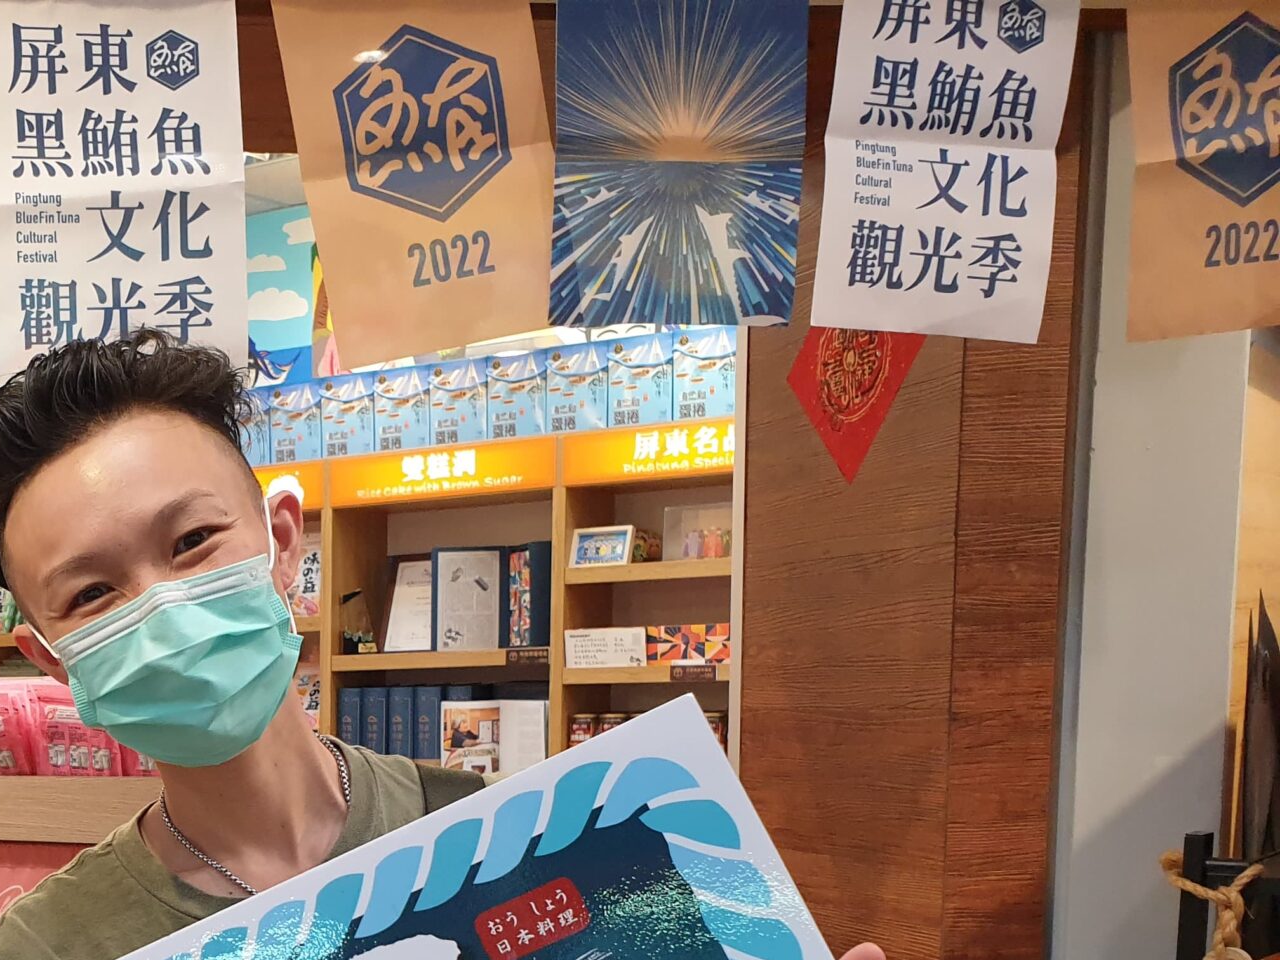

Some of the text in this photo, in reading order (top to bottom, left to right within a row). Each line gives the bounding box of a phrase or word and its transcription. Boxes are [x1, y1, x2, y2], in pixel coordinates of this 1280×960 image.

[8, 22, 137, 95] 屏東
[859, 55, 1037, 143] 黑鮪魚
[11, 108, 211, 178] 黑鮪魚
[855, 140, 897, 156] Pingtung
[856, 157, 914, 173] BlueFin Tuna
[15, 193, 62, 207] Pingtung
[854, 192, 890, 207] Festival
[855, 174, 892, 189] Cultural
[917, 148, 1028, 218] 文化
[15, 211, 80, 224] BlueFin Tuna
[16, 231, 57, 244] Cultural
[86, 190, 213, 262] 文化
[17, 250, 57, 263] Festival
[407, 230, 495, 288] 2022
[847, 219, 1023, 299] 觀光季
[1204, 219, 1280, 268] 2022
[19, 275, 214, 351] 觀光季
[623, 460, 690, 474] Pingtung
[497, 908, 578, 954] 日本料理
